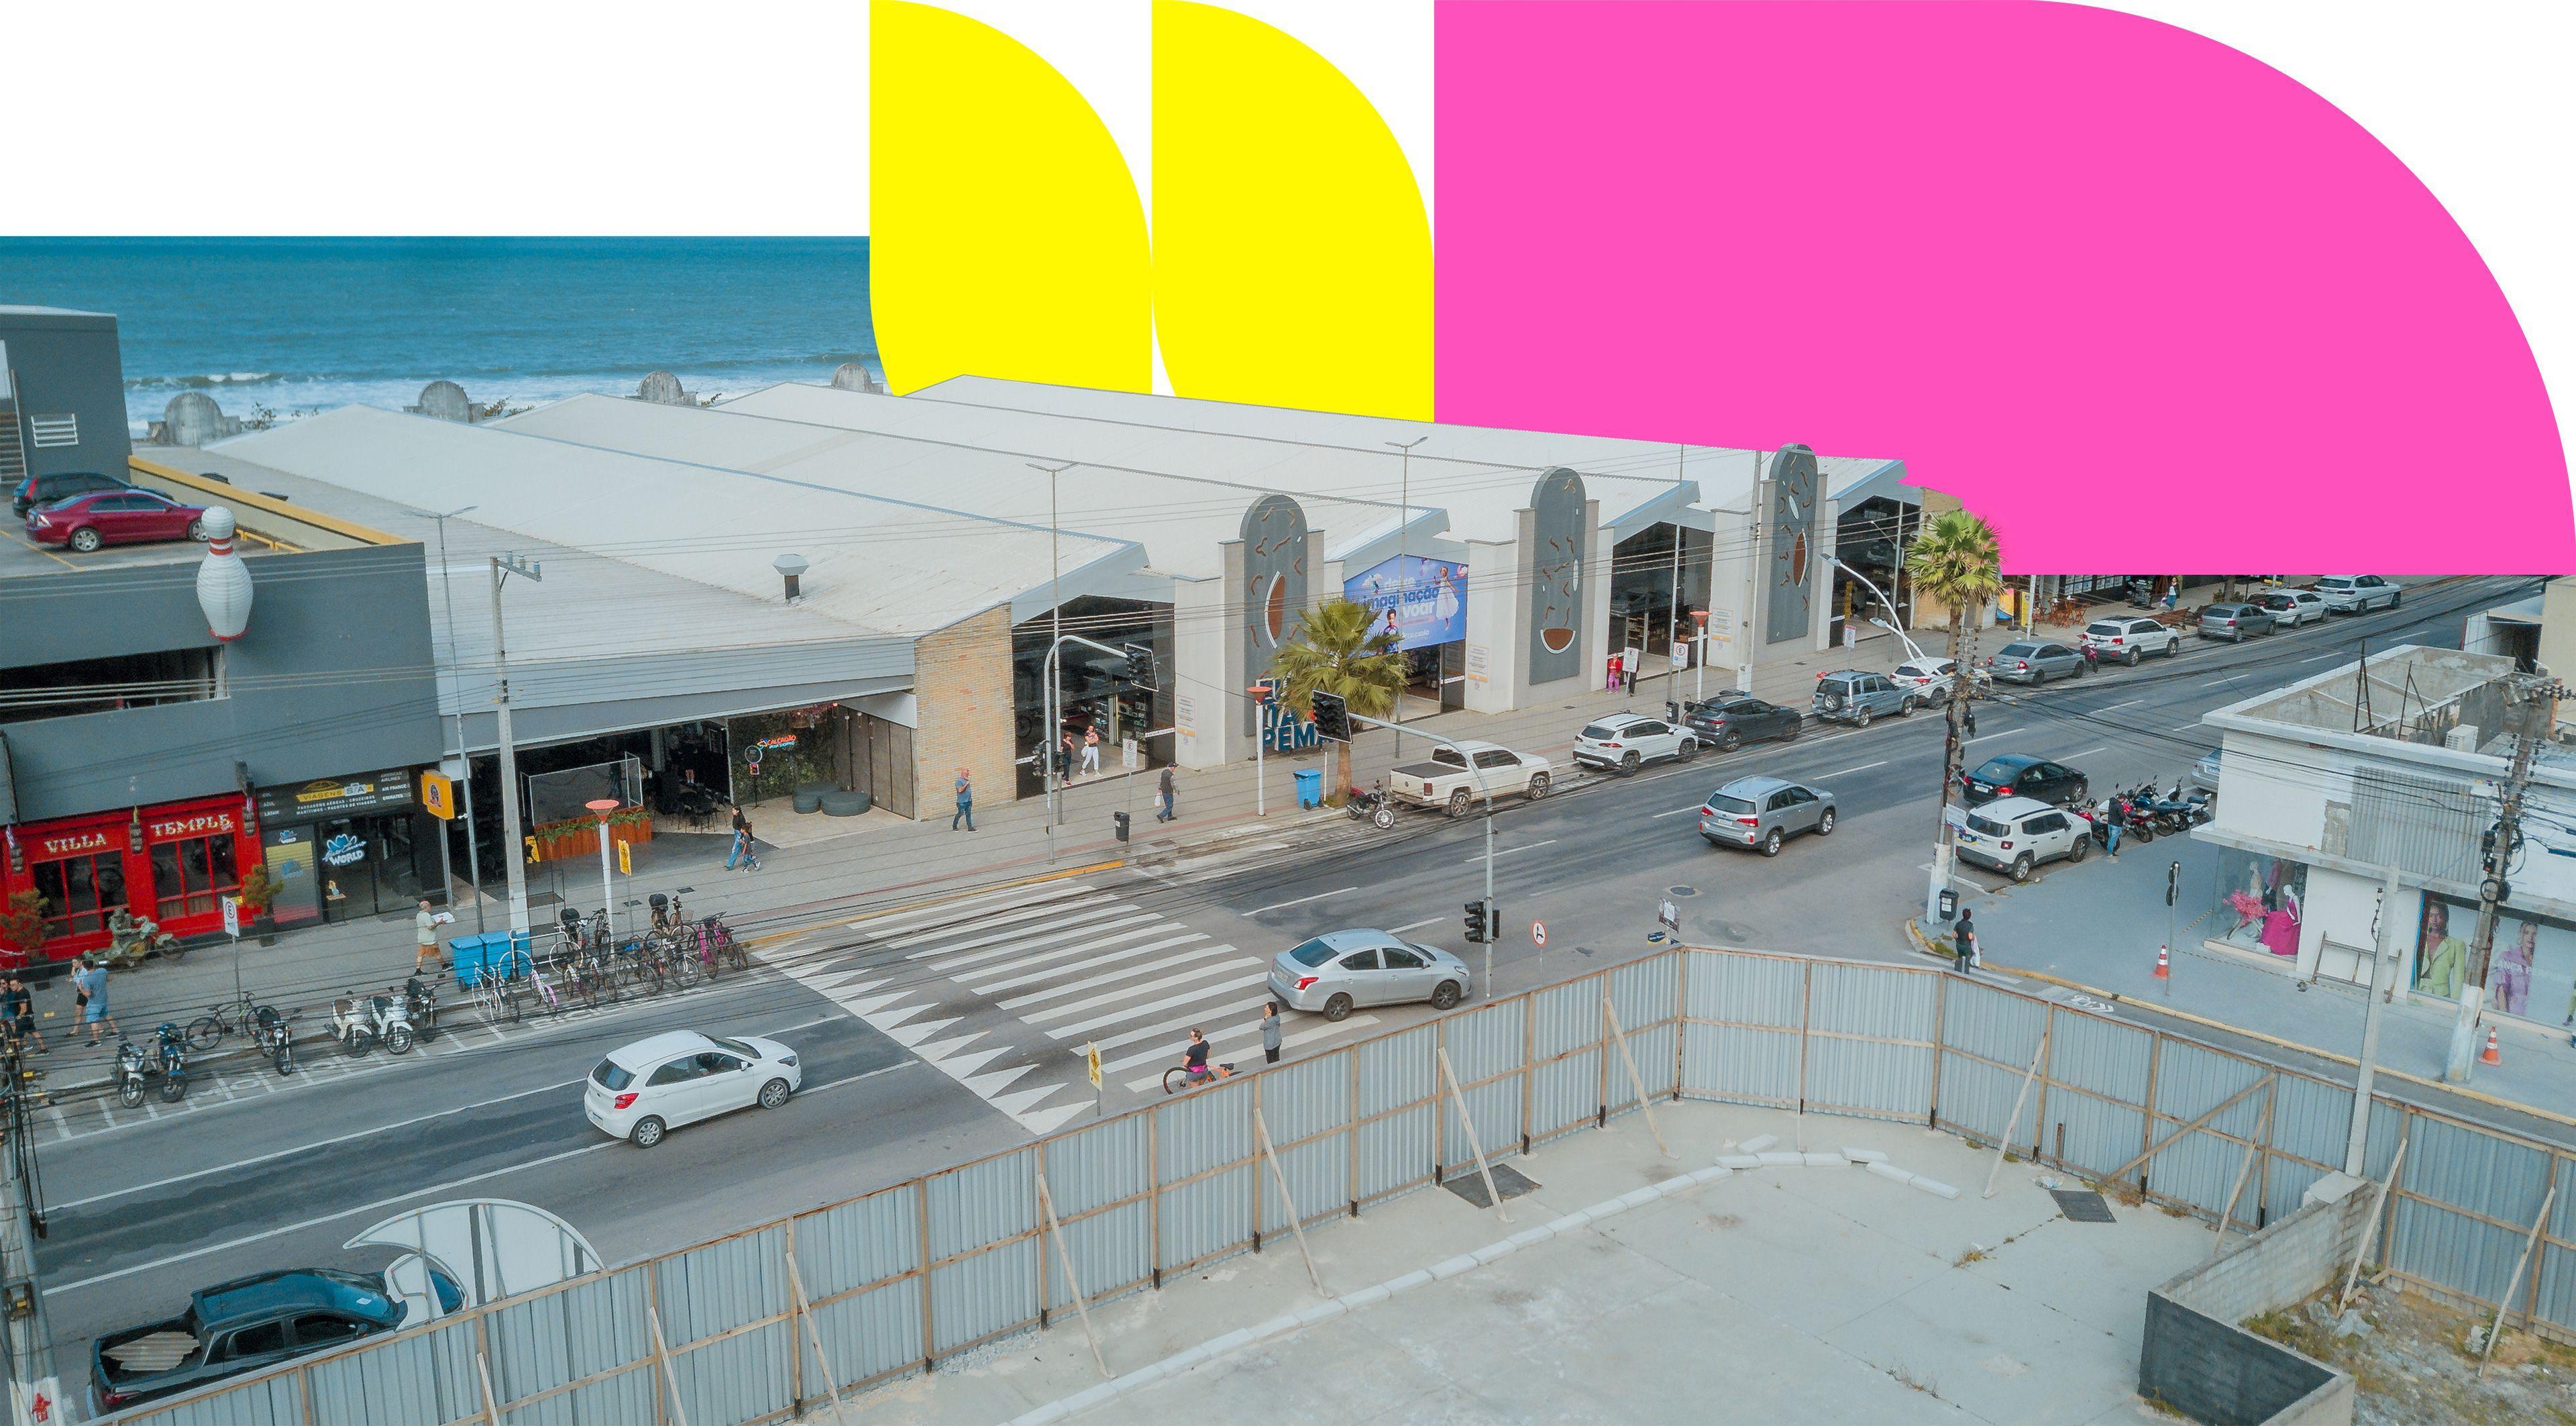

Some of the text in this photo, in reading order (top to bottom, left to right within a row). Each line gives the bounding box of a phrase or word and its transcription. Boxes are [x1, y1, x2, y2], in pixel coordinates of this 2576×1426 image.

[1403, 601, 1435, 618] voar
[302, 790, 343, 801] VIAGENS
[150, 814, 231, 837] TEMPLE
[44, 833, 107, 854] VILLA
[329, 850, 365, 866] WORLD
